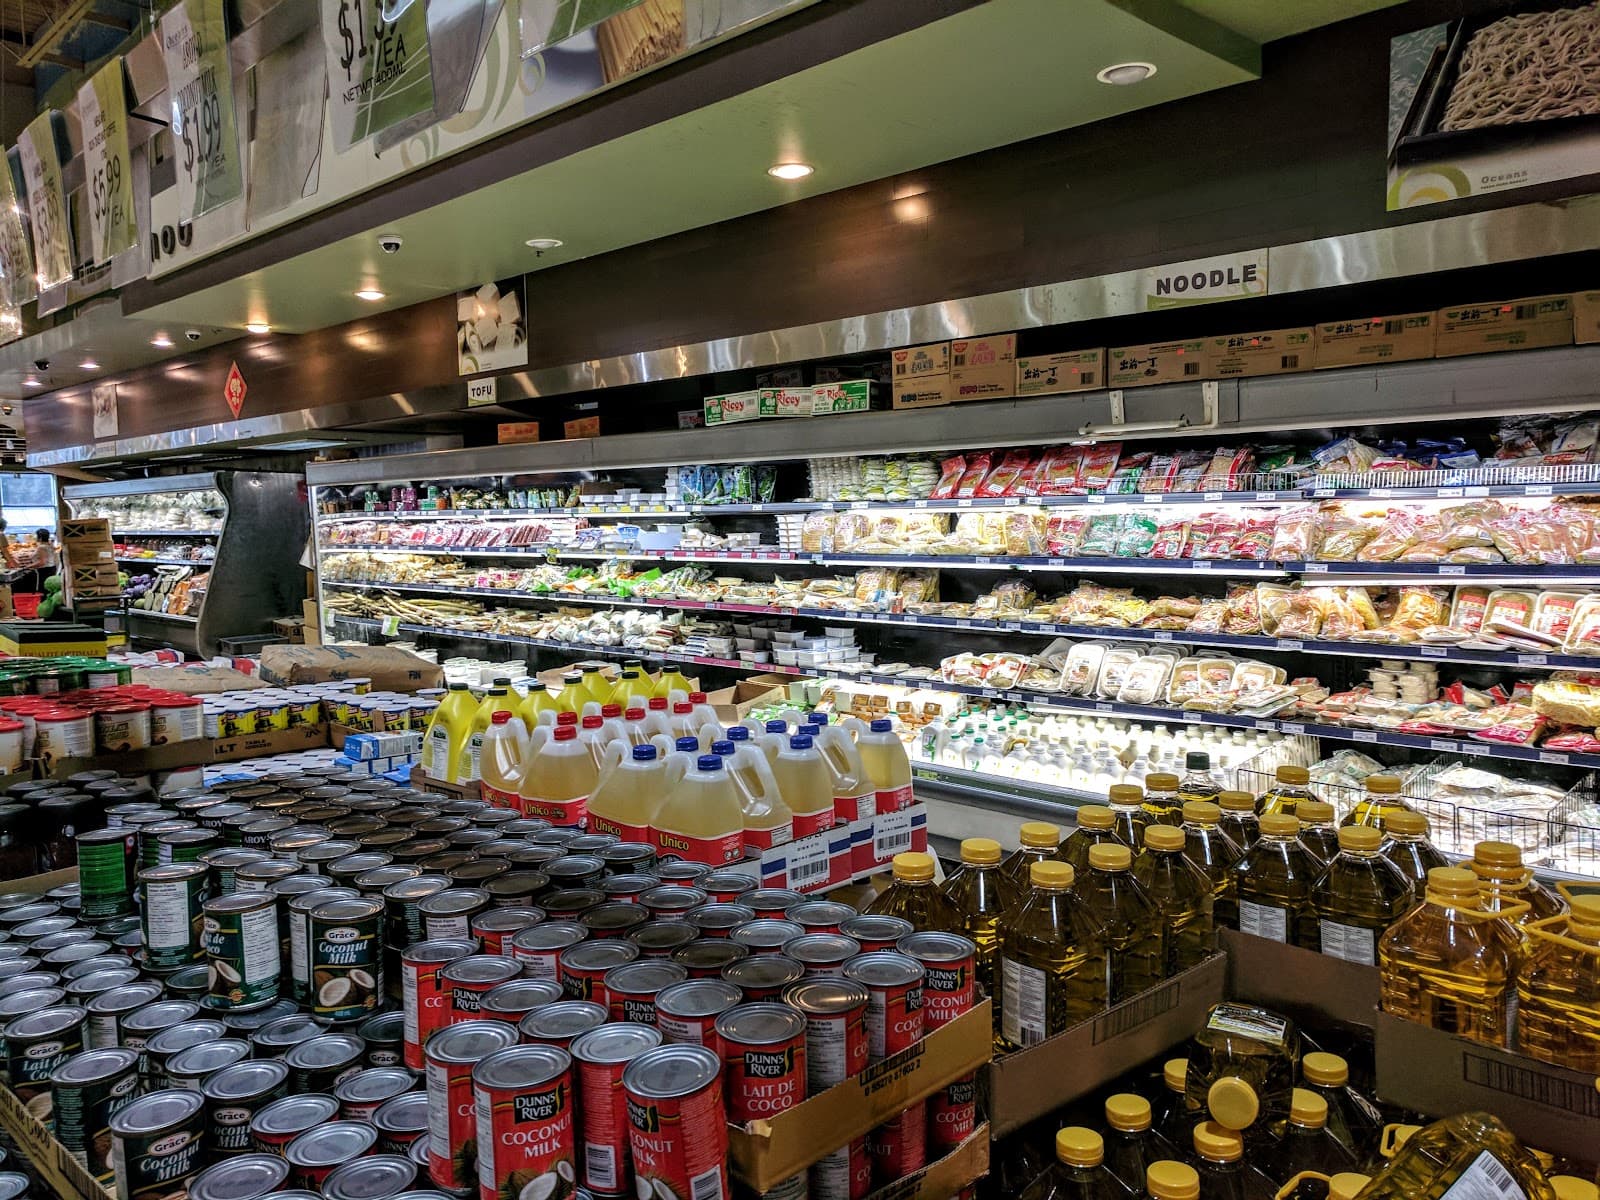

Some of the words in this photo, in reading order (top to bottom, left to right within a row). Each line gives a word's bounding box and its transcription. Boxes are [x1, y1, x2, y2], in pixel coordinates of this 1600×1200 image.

[1156, 263, 1258, 296] NOODLE
[471, 384, 493, 398] TOFU
[525, 803, 550, 816] Unico
[595, 818, 621, 836] Unico
[659, 833, 690, 851] Unico
[328, 931, 356, 939] Grace
[318, 939, 369, 954] Coconut
[327, 951, 358, 965] Milk
[924, 968, 958, 981] DUNN'S
[928, 978, 954, 993] RIVER
[629, 1010, 656, 1023] RIVER
[29, 1046, 59, 1056] Grace
[371, 1054, 397, 1062] Grace
[745, 1052, 785, 1064] DUNN'S
[23, 1059, 51, 1072] Lait
[53, 1053, 70, 1069] de
[751, 1063, 781, 1077] RIVER
[743, 1084, 774, 1098] LAIT
[778, 1079, 796, 1094] DE
[516, 1092, 556, 1109] DUNN'S
[747, 1095, 793, 1112] COCO
[216, 1111, 246, 1120] Grace
[521, 1104, 553, 1120] RIVER
[501, 1112, 572, 1146] COCONUT
[154, 1135, 188, 1153] Grace
[217, 1134, 249, 1148] Milk
[524, 1137, 562, 1160] MILK
[140, 1140, 201, 1172] Coconut
[156, 1160, 191, 1182] Milk
